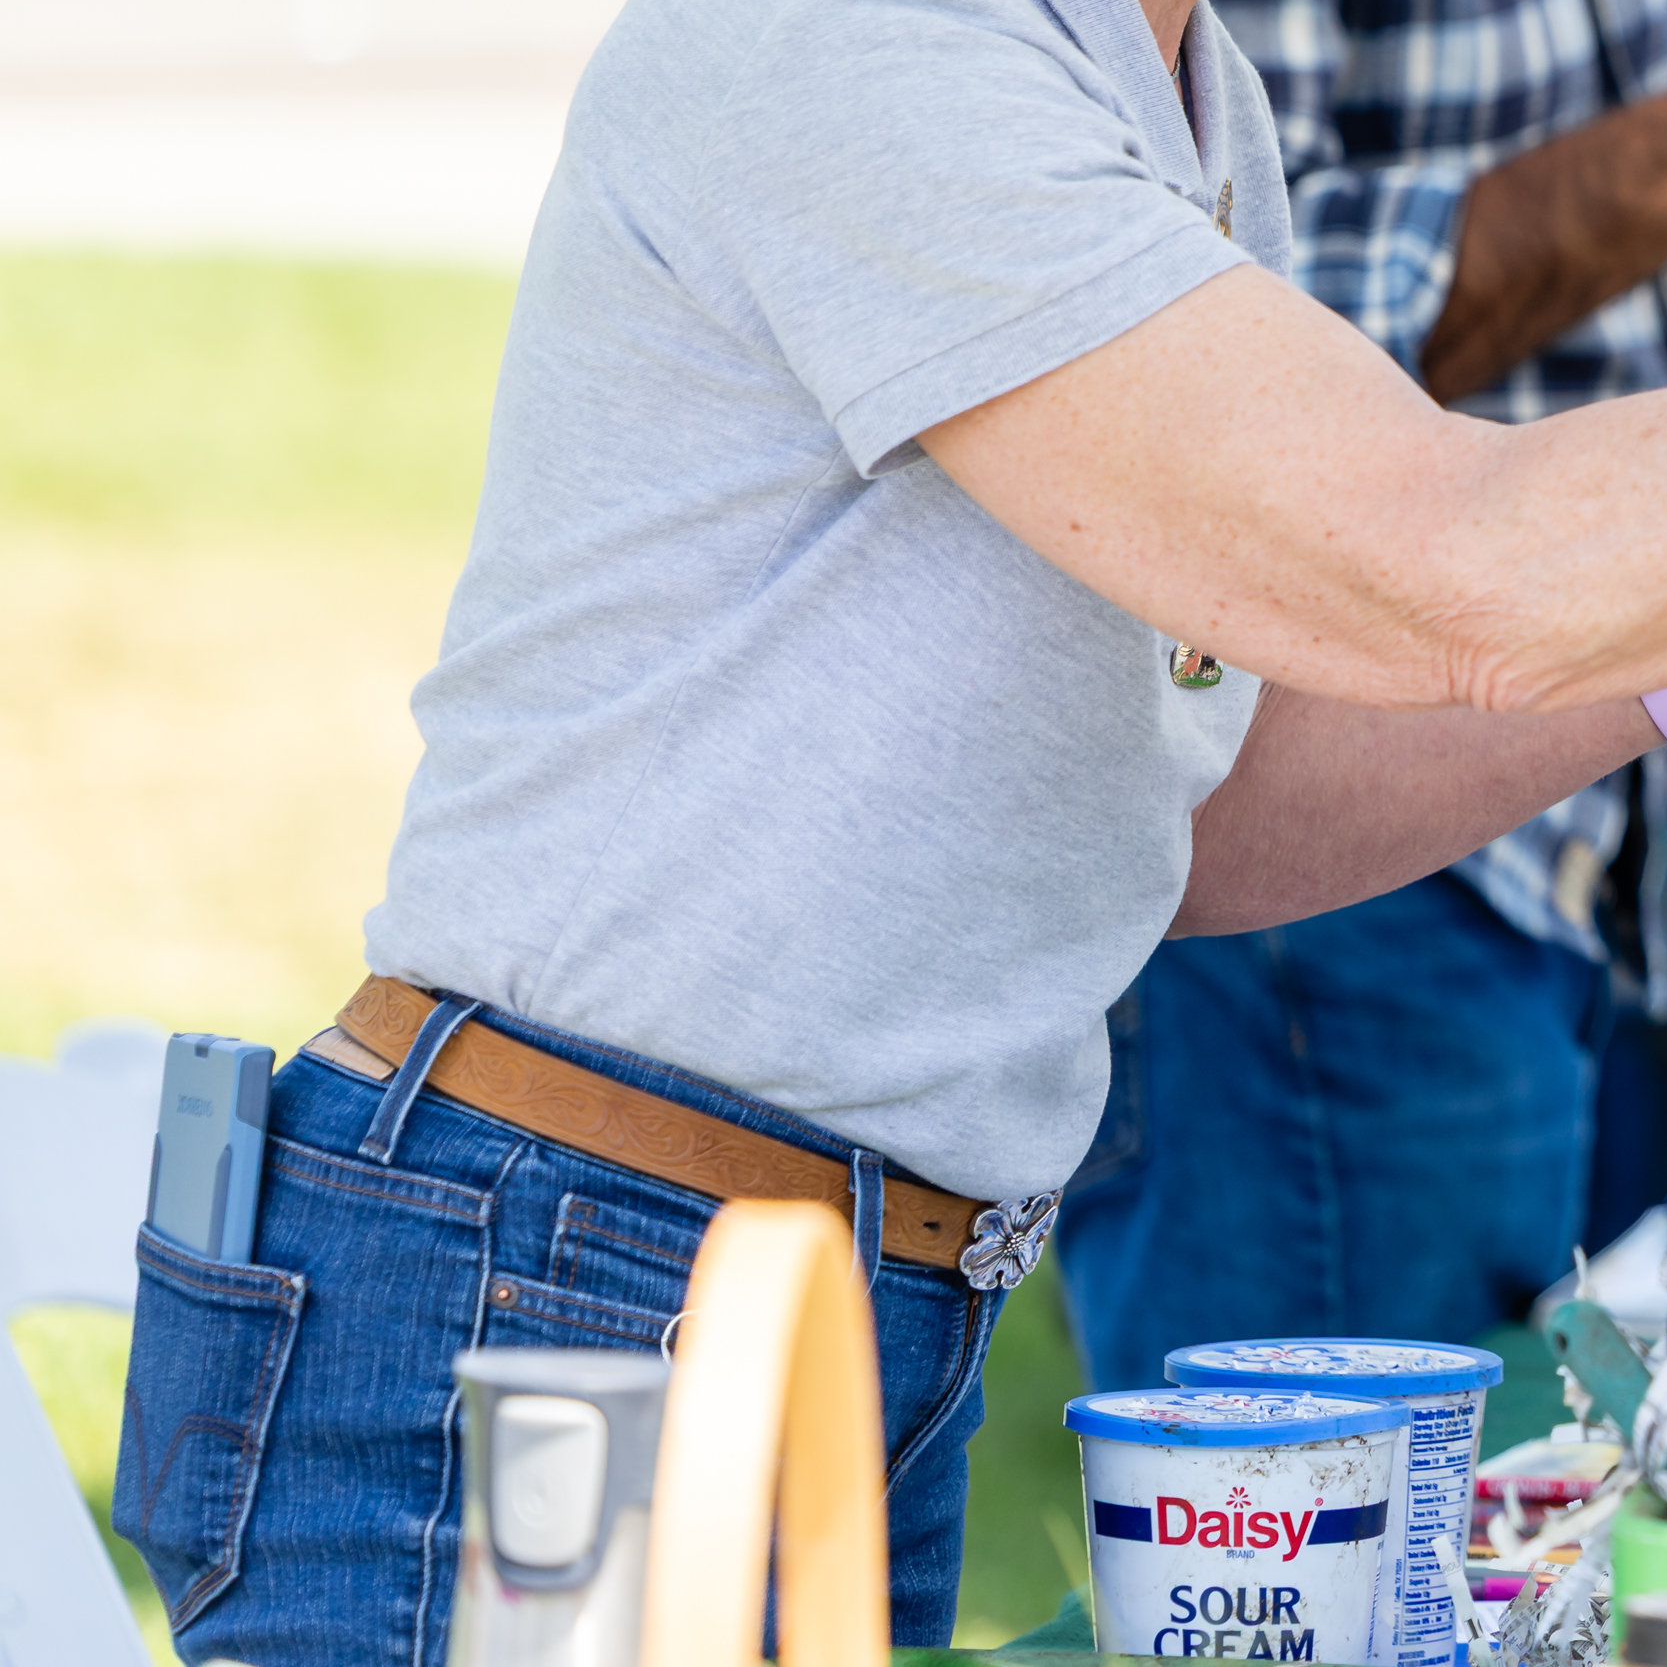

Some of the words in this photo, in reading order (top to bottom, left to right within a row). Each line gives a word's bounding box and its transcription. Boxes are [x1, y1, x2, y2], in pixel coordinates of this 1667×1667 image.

[1157, 1487, 1314, 1562] Daisy
[1226, 1549, 1255, 1560] BRAND
[1170, 1584, 1301, 1627] SOUR
[1153, 1627, 1316, 1663] CREAM
